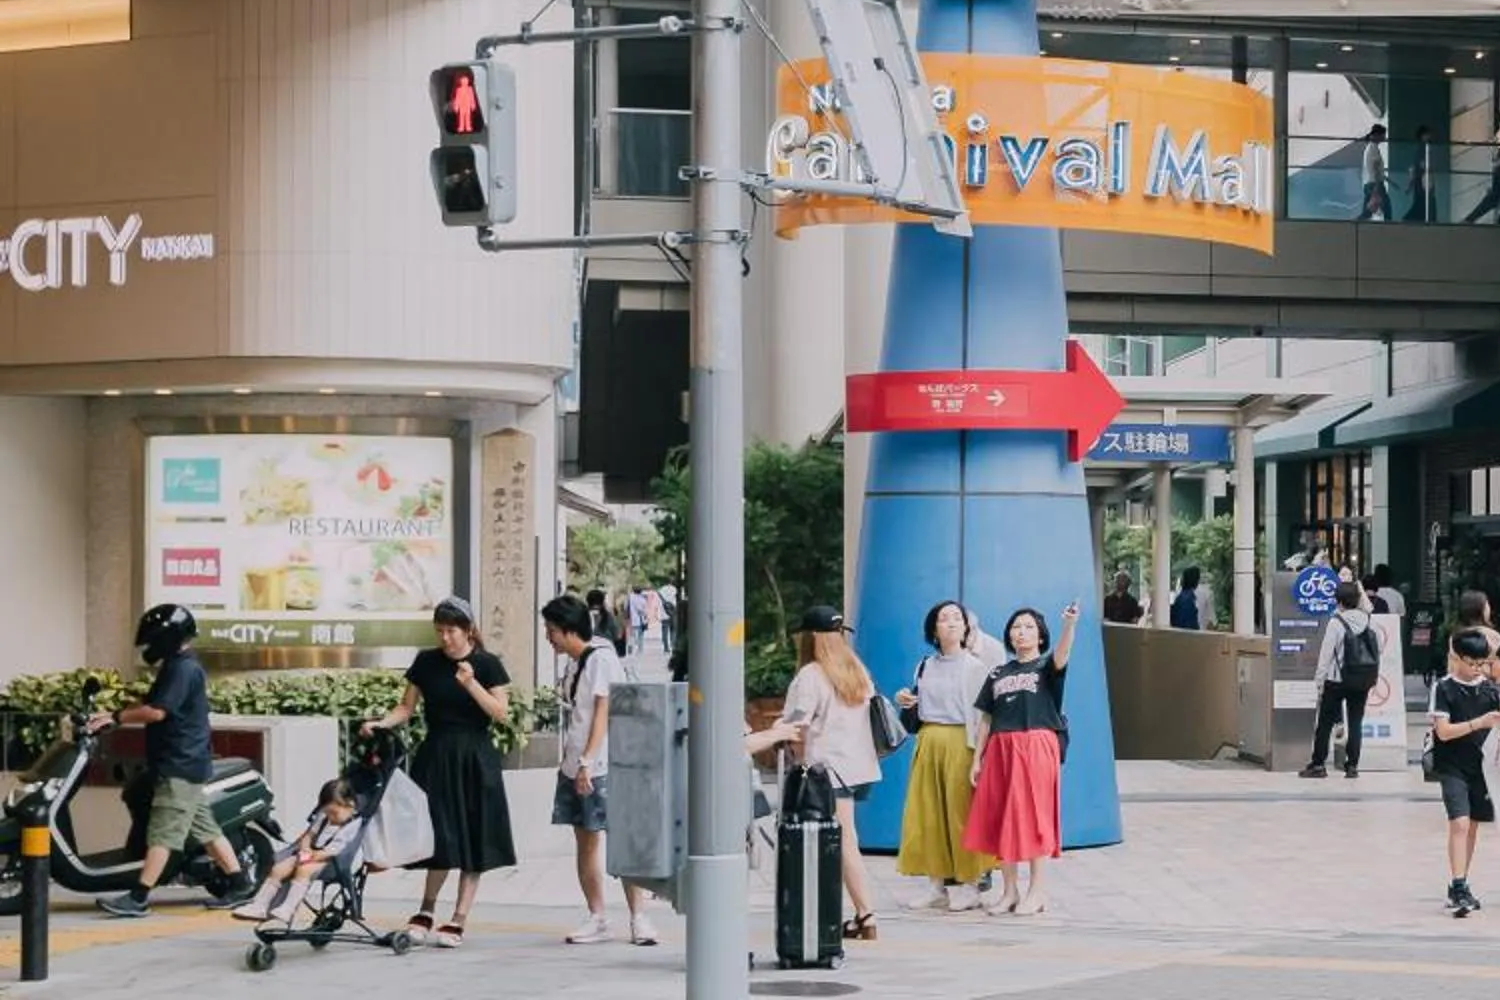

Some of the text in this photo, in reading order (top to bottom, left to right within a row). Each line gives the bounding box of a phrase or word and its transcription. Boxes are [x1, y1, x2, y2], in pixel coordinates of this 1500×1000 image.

[766, 114, 1274, 214] Caival Mall
[288, 517, 437, 537] RESTAURANT
